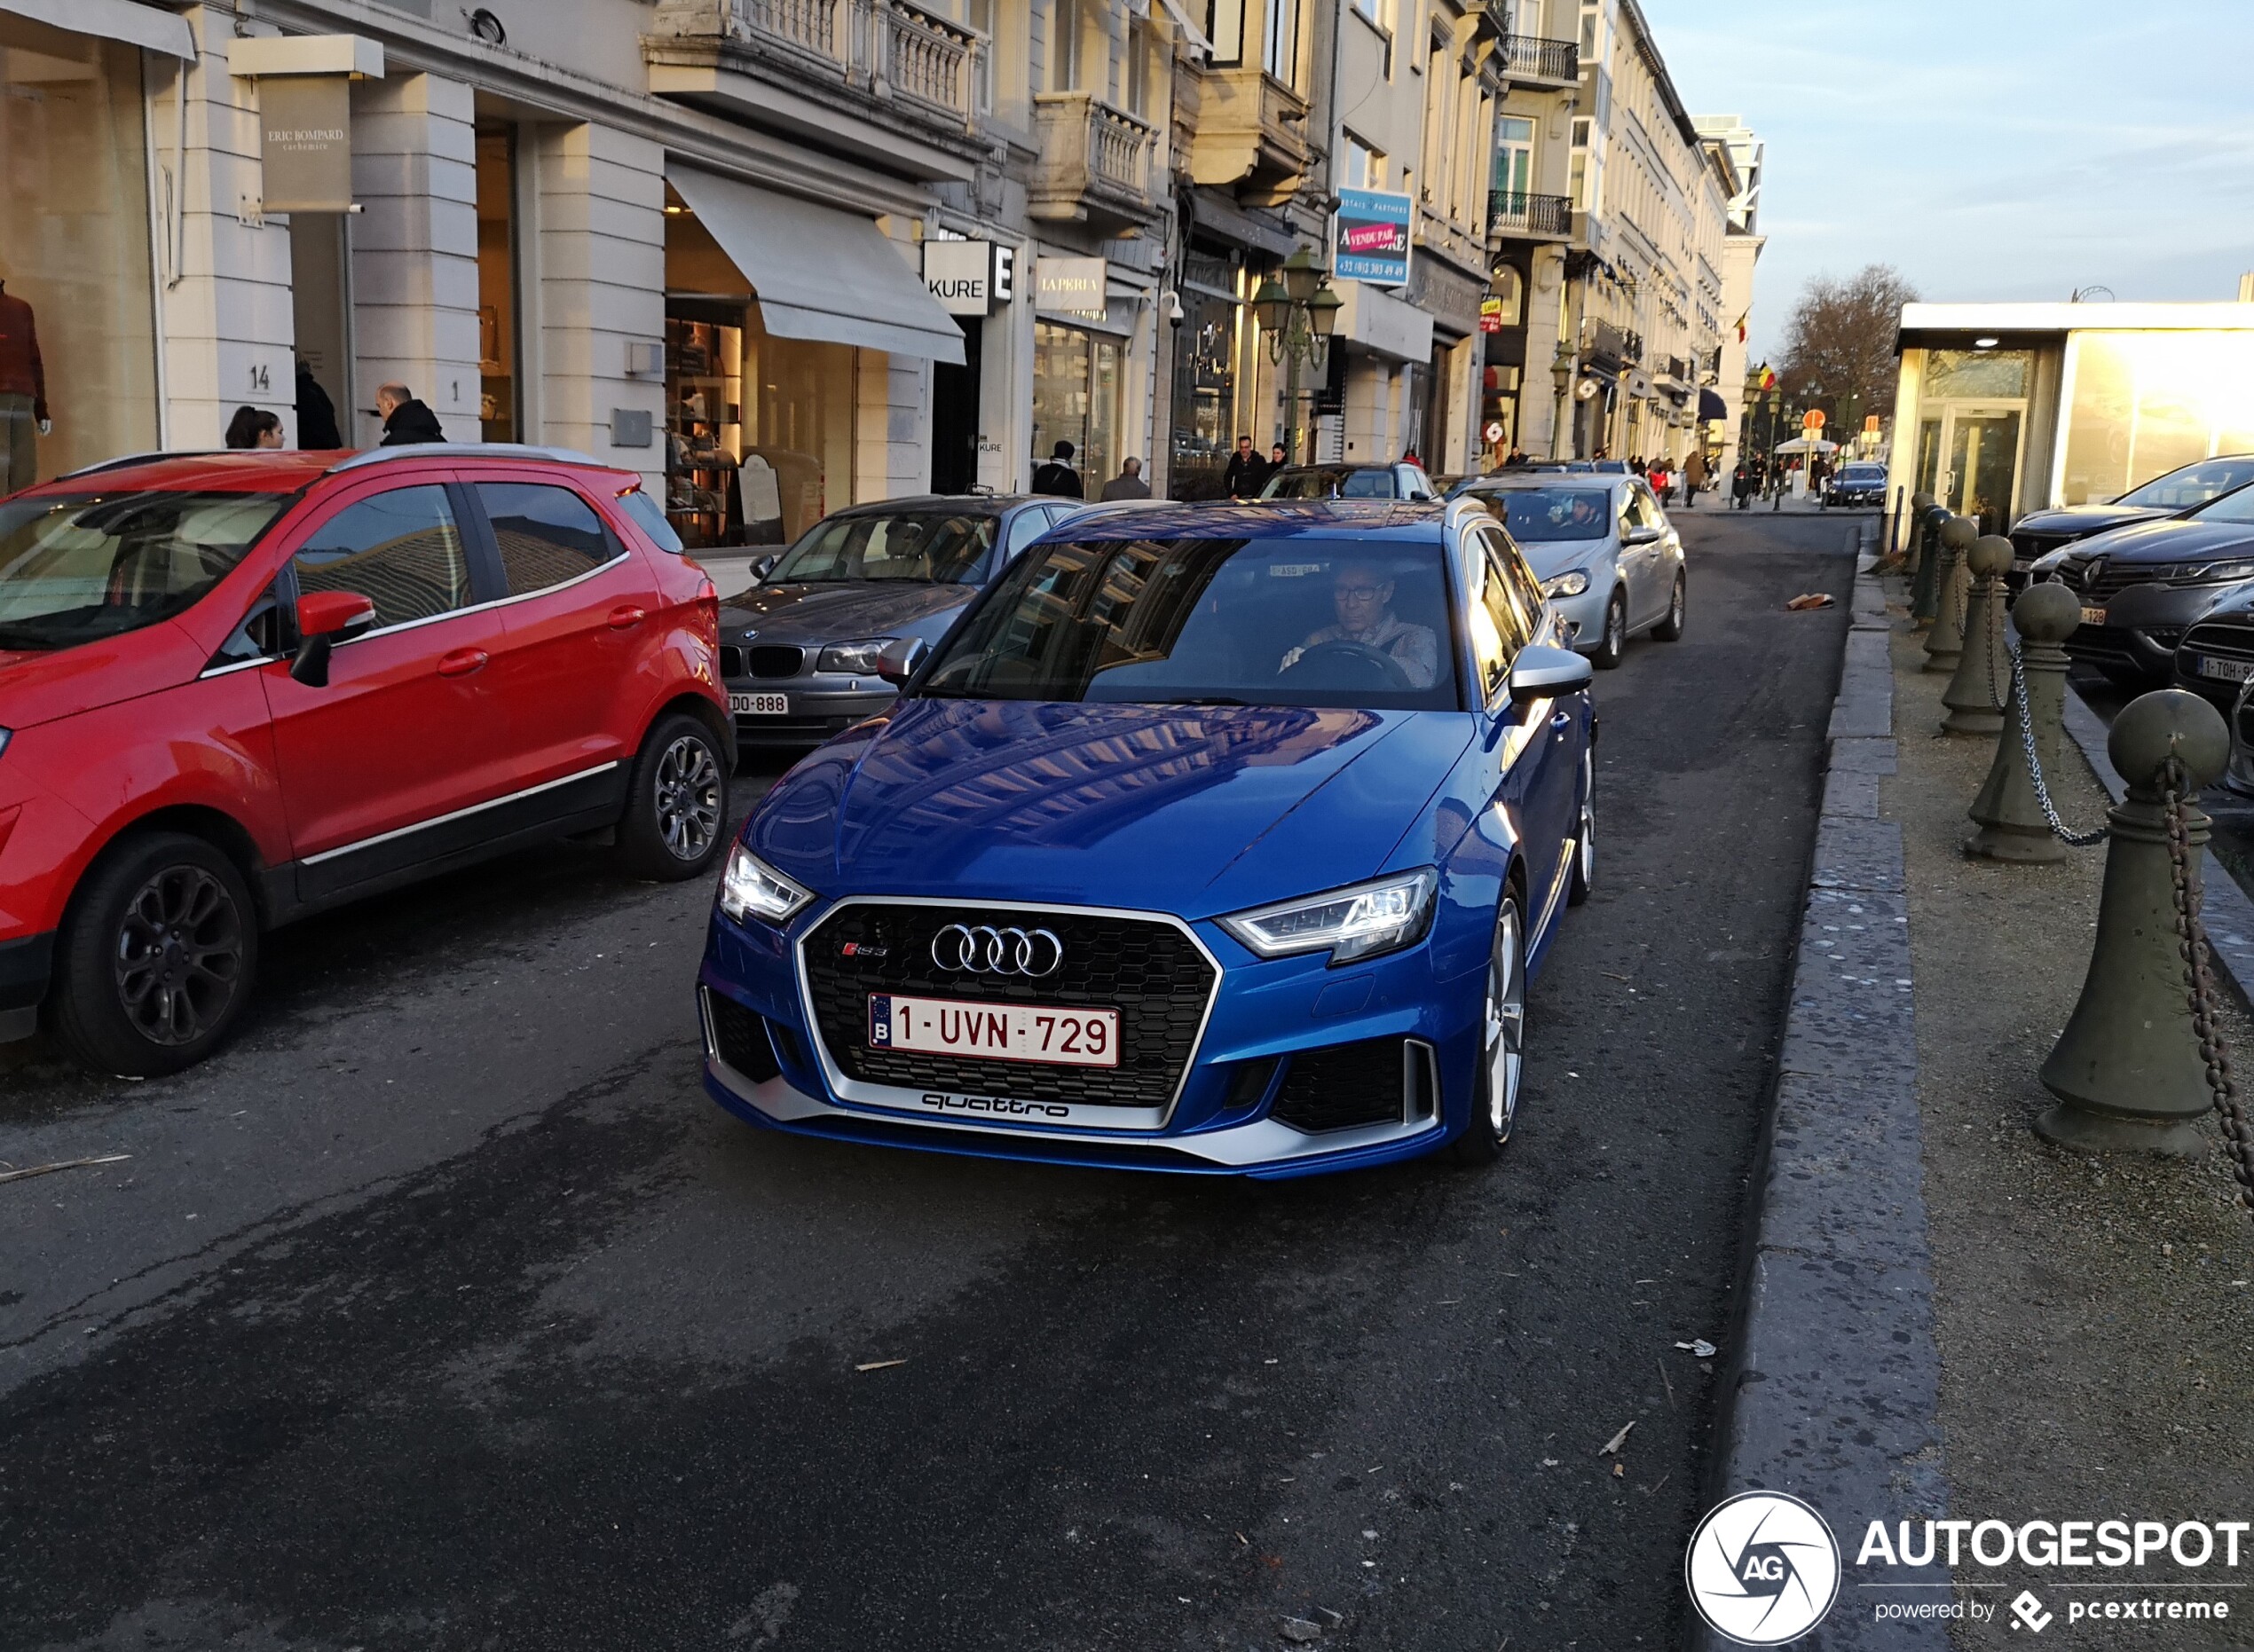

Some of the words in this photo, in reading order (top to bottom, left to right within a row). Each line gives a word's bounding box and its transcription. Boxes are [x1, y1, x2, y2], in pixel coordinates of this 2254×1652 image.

[268, 130, 292, 142] ERIC
[295, 130, 343, 142] BOMPARD
[1351, 231, 1377, 246] VENDU
[1377, 228, 1394, 242] PAR
[929, 279, 983, 298] KURE
[1042, 278, 1056, 292] LA
[1058, 277, 1097, 292] PERLA
[250, 365, 269, 389] 14
[979, 443, 1002, 452] KURE
[729, 696, 784, 712] DO-888
[875, 1023, 888, 1040] B
[899, 1005, 1107, 1055] 1-UVN-729
[921, 1093, 1070, 1118] quattro
